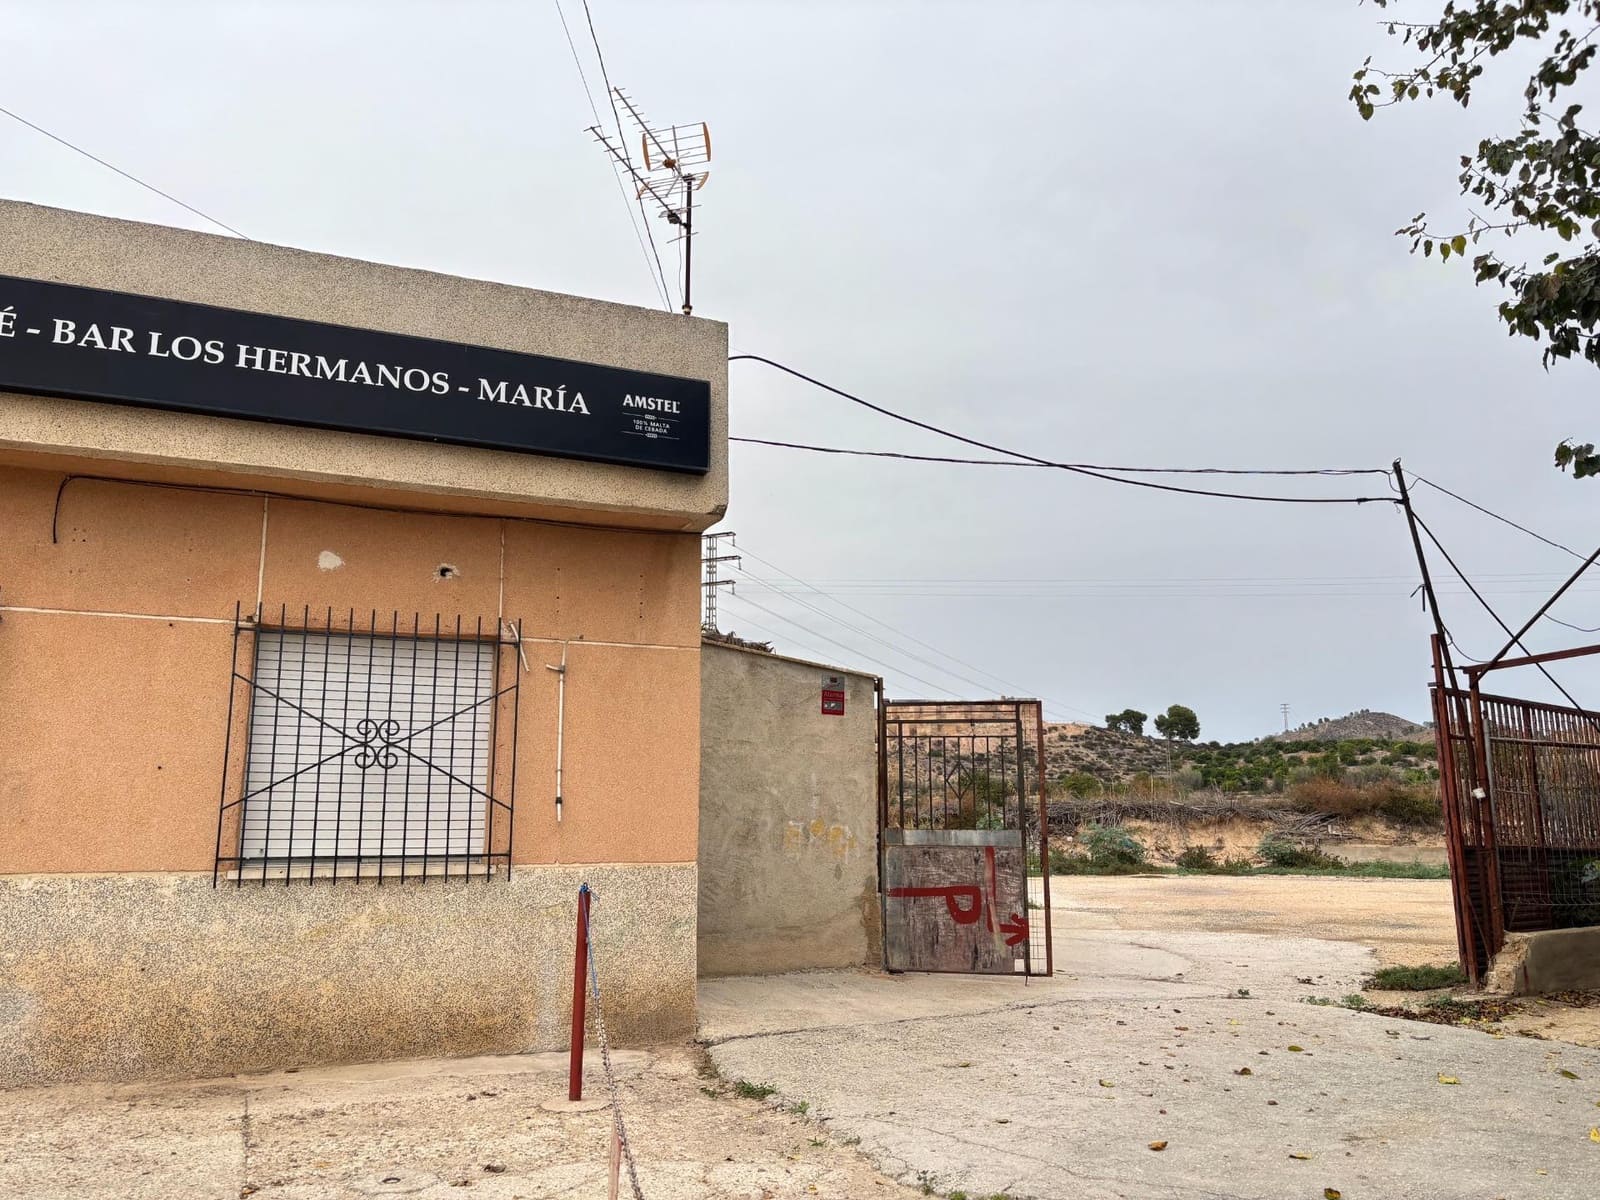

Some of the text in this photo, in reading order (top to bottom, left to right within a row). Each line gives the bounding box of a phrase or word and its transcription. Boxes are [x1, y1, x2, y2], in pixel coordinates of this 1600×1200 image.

[51, 318, 137, 353] BAR
[147, 331, 225, 364] LOS
[235, 343, 450, 395] HERMANOS
[477, 377, 591, 415] MARÍA
[623, 394, 680, 413] AMSTEL
[644, 425, 668, 434] CEBADA
[650, 421, 671, 429] MALTA
